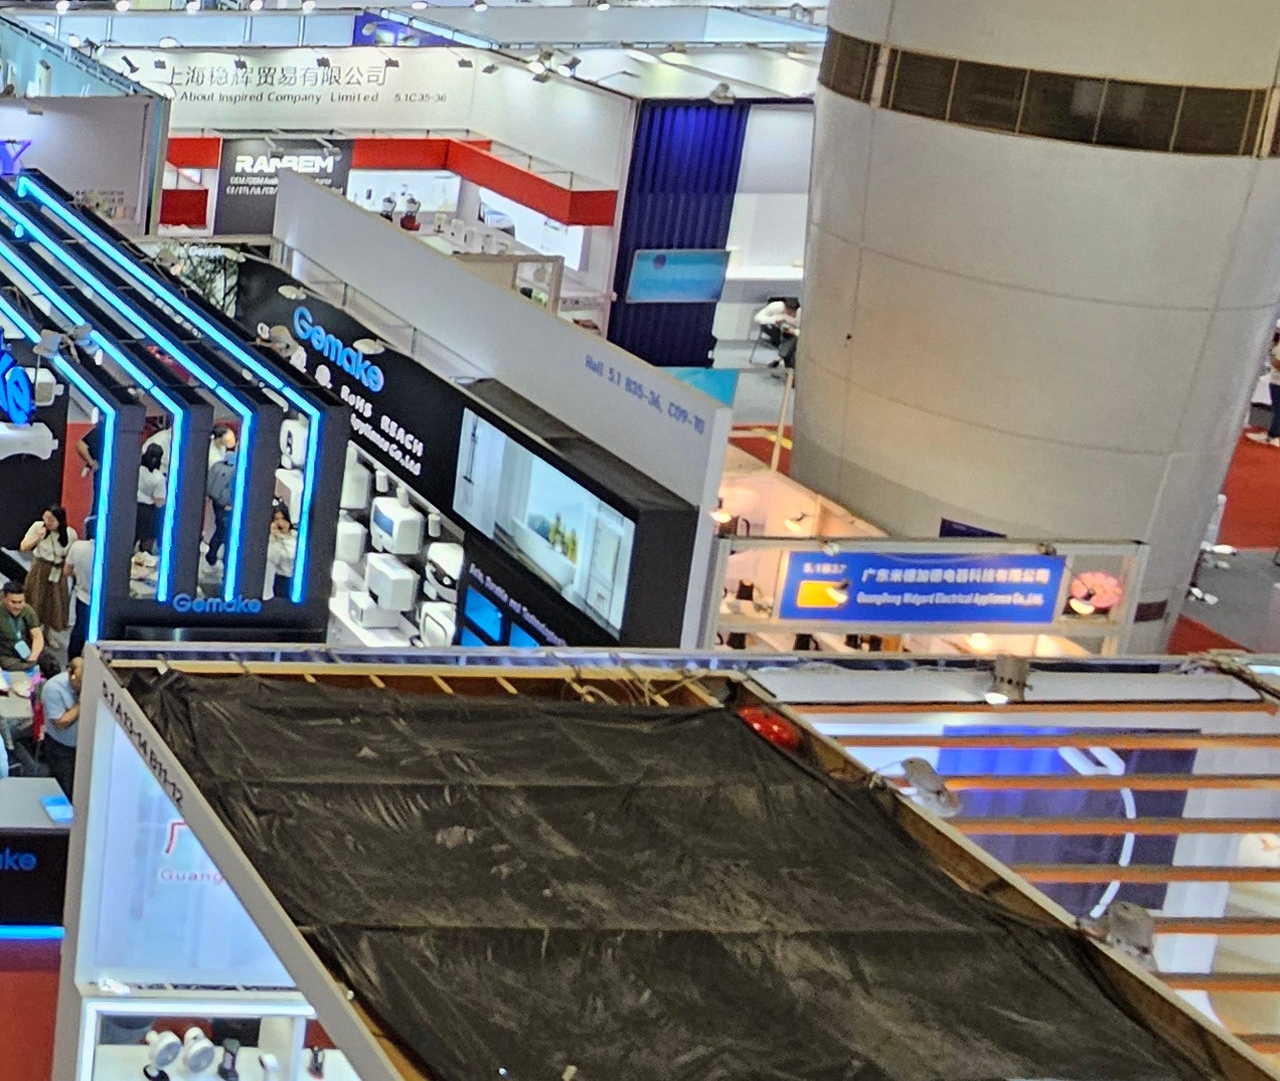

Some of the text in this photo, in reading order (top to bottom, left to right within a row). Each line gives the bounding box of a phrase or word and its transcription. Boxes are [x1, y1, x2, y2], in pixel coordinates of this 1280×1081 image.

[180, 91, 215, 102] About
[219, 91, 263, 104] Inspired
[267, 92, 322, 105] Company
[330, 91, 379, 102] Limited
[293, 306, 385, 393] Gemake
[340, 384, 424, 458] RoHS REACH
[172, 593, 262, 615] Gemake
